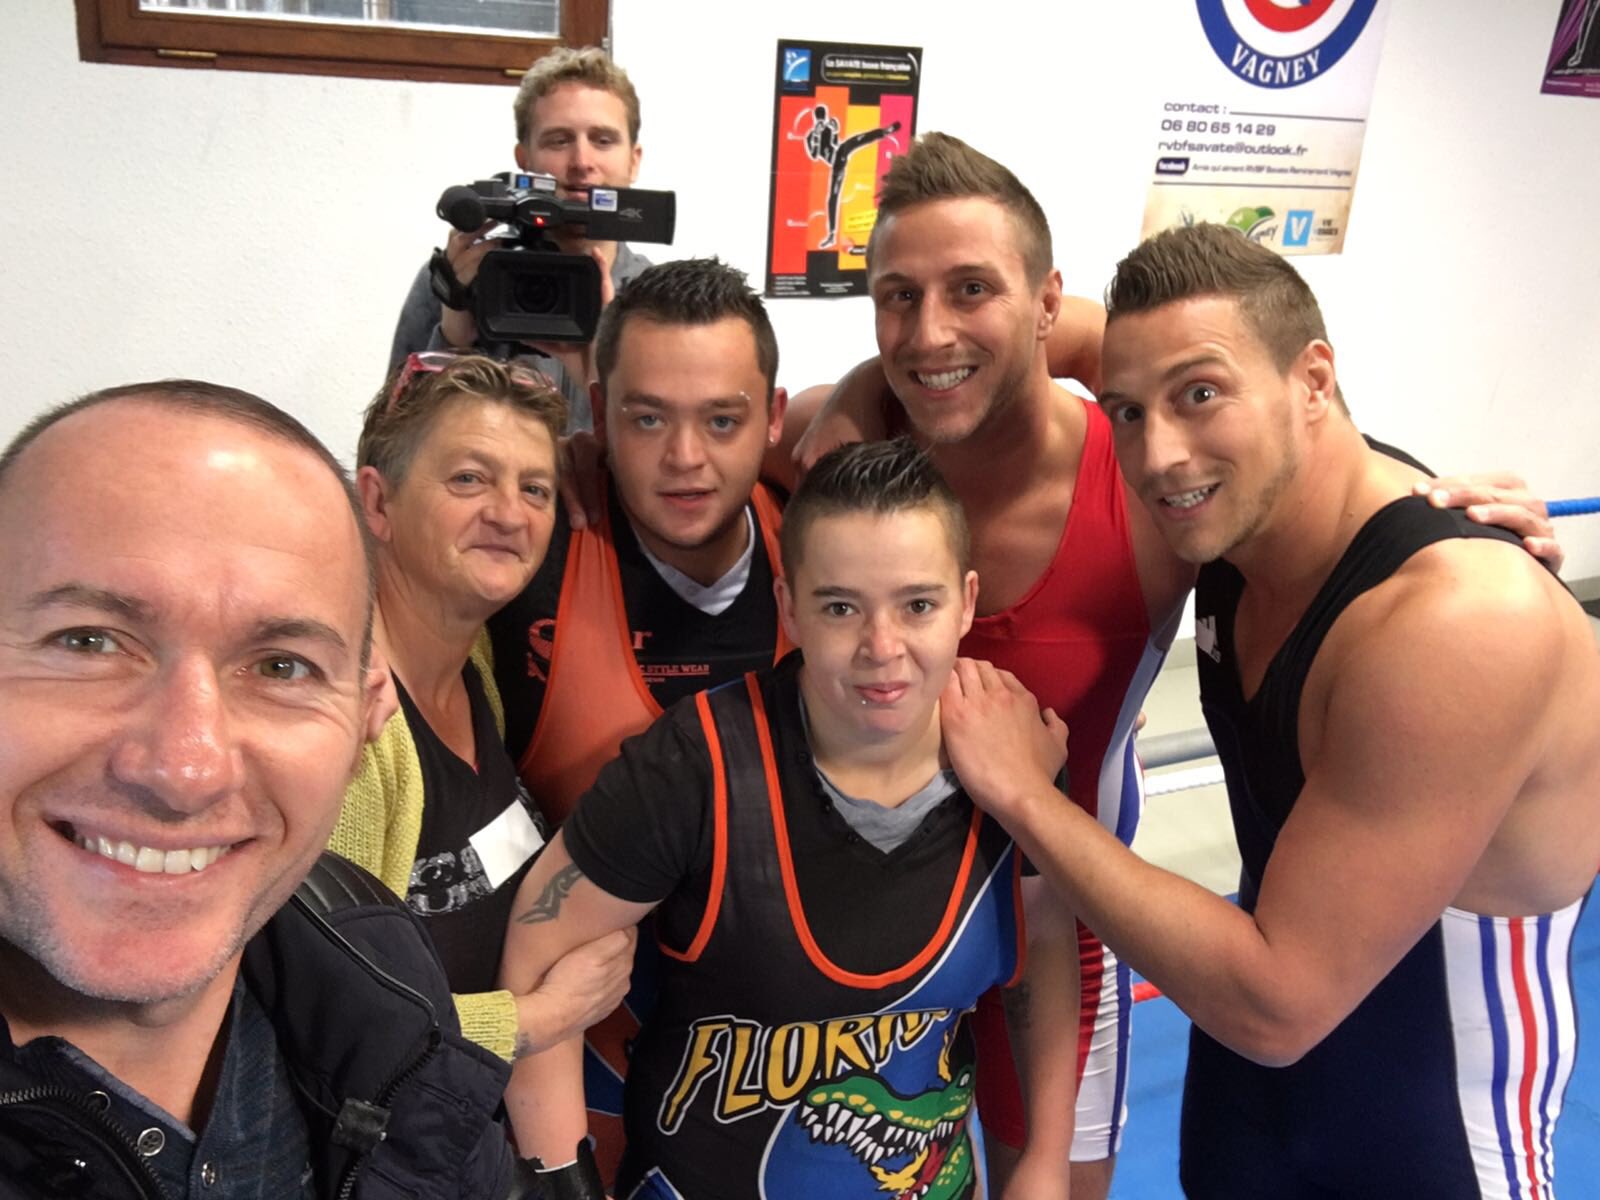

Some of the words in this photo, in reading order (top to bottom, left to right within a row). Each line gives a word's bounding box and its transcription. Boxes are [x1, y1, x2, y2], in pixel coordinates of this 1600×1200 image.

[1231, 42, 1321, 84] VAGNEY
[1163, 102, 1220, 115] contact
[1160, 119, 1183, 132] 06
[1186, 120, 1208, 133] 80
[1210, 122, 1231, 134] 65
[1235, 123, 1253, 135] 14
[1255, 124, 1276, 136] 29
[1158, 140, 1308, 157] rvbfsavate@outlook.fr
[619, 208, 643, 220] 4K
[647, 665, 680, 674] STYLE
[680, 663, 710, 674] WEAR
[657, 1014, 953, 1135] FLORI
